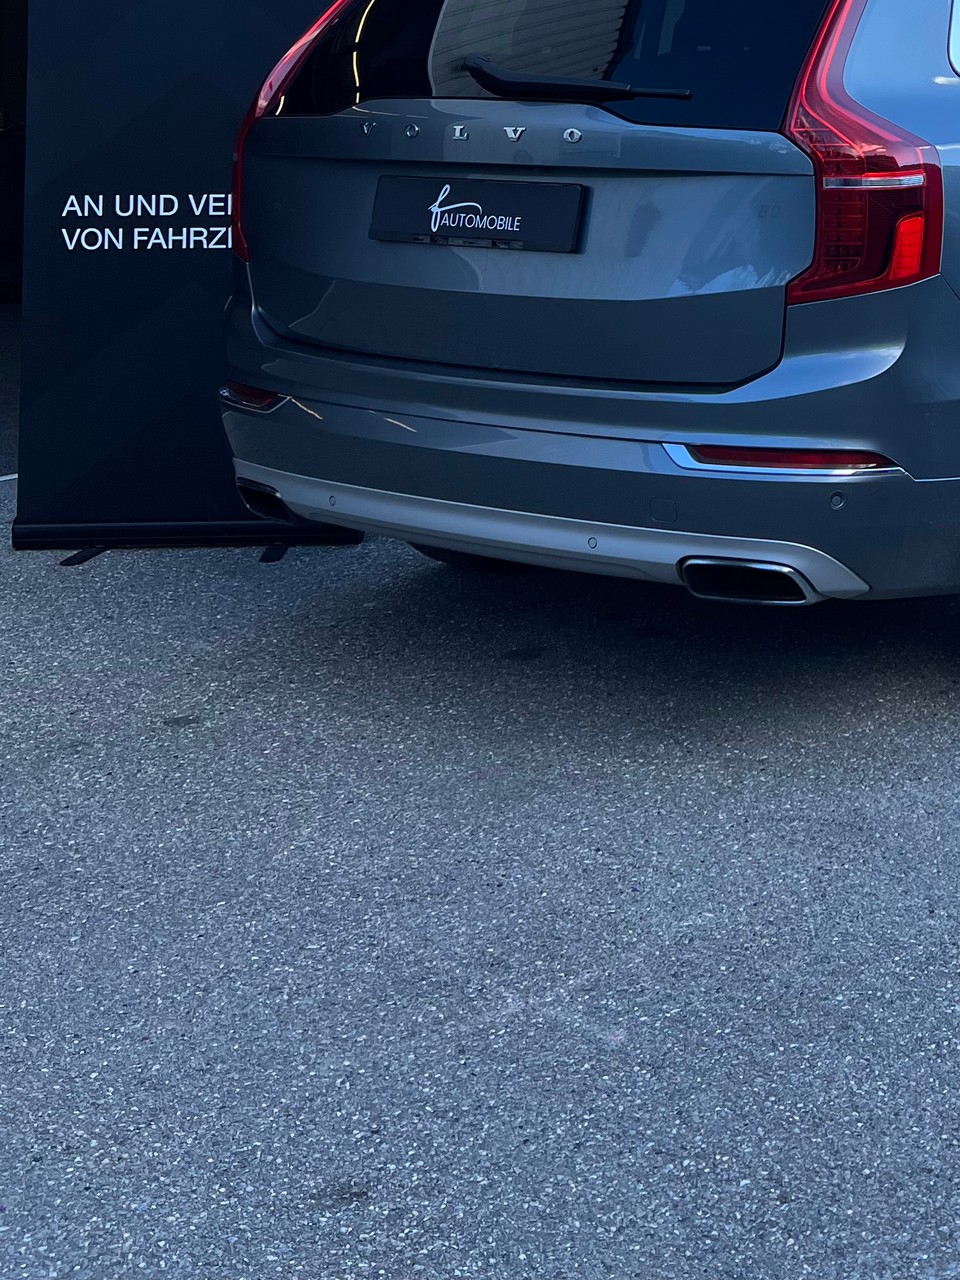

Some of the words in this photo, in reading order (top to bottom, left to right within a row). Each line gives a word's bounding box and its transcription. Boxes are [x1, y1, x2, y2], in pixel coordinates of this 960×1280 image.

[361, 122, 582, 143] VOLVO
[61, 194, 103, 217] AN
[115, 194, 178, 217] UND
[188, 193, 232, 216] VE
[440, 213, 521, 231] AUTOMOBILE
[61, 227, 123, 250] VON
[133, 226, 232, 250] FAHRZ
